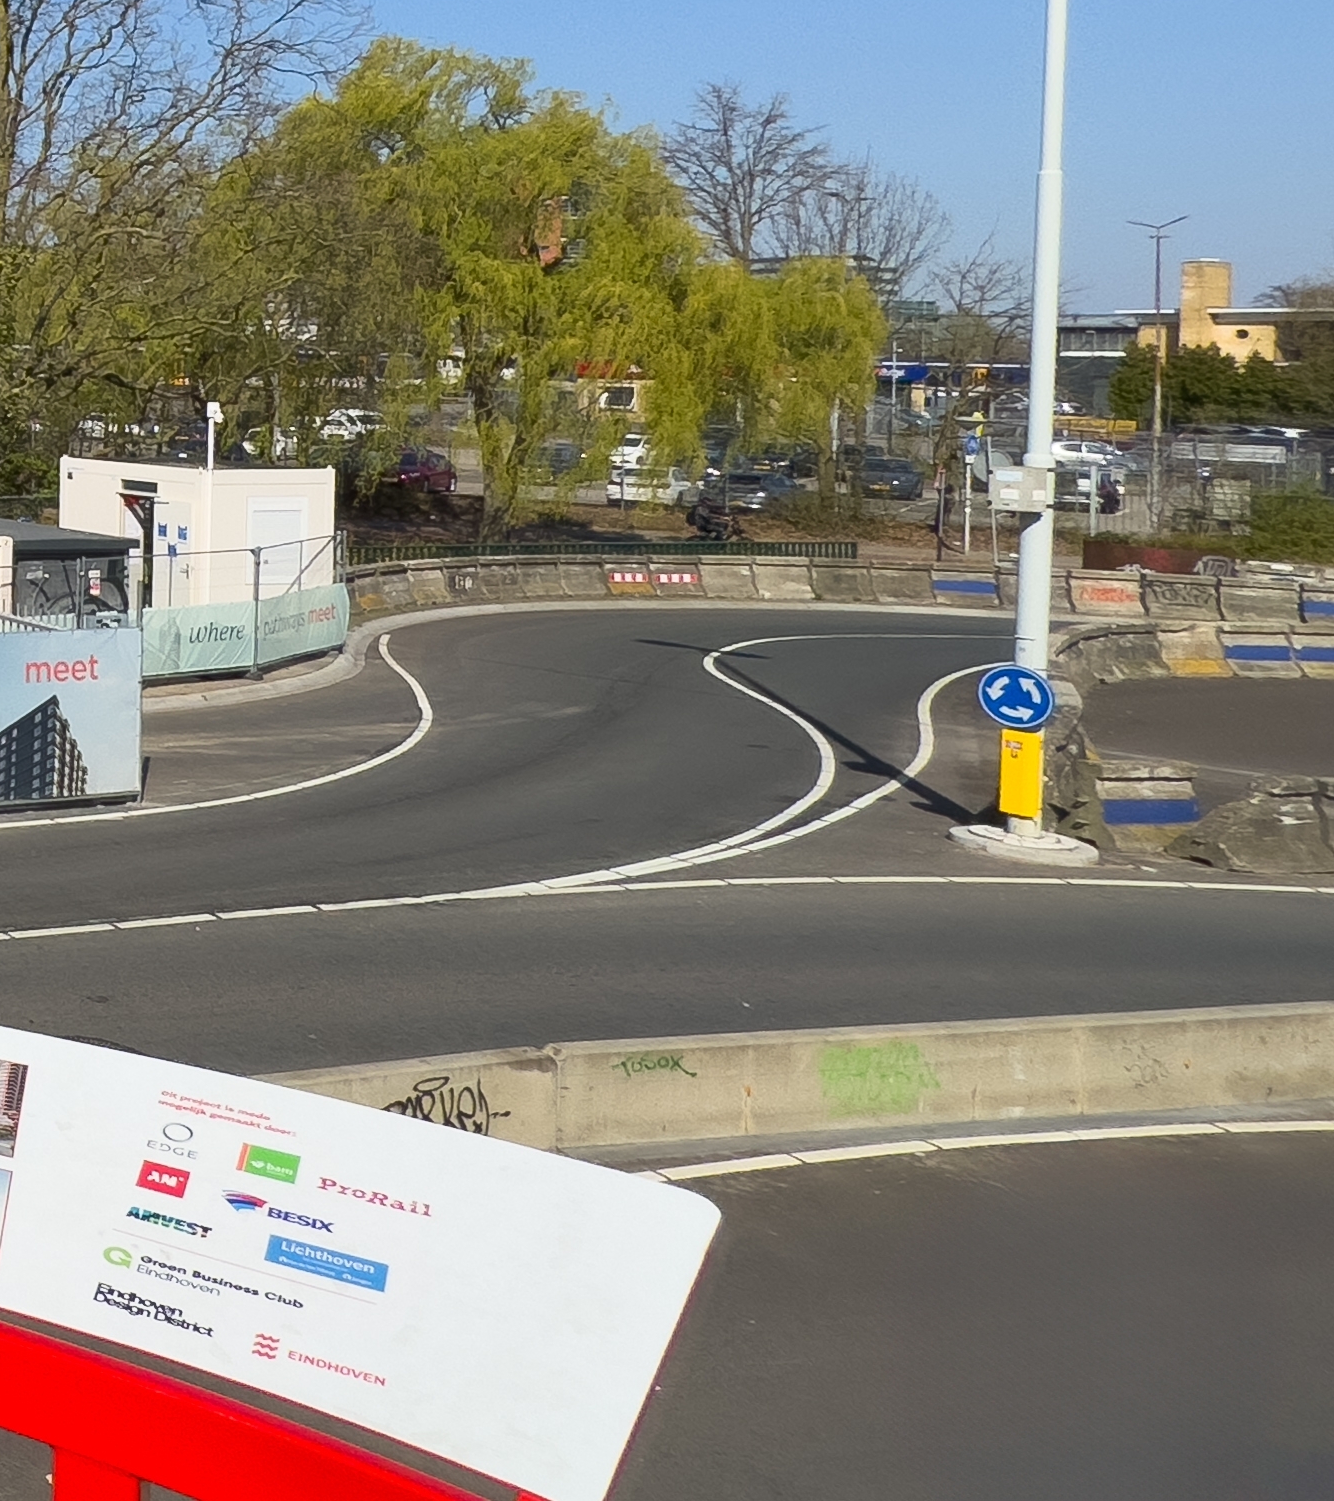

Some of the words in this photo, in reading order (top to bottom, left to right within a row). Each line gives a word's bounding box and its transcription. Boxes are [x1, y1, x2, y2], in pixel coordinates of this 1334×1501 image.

[189, 621, 245, 644] where
[308, 602, 337, 625] meet
[25, 654, 99, 684] meet
[158, 1099, 207, 1116] mogelijk
[209, 1111, 262, 1129] gemaakt
[161, 1089, 178, 1099] Dit
[180, 1095, 222, 1110] project
[224, 1104, 235, 1112] is
[237, 1109, 271, 1121] mede
[146, 1139, 198, 1160] EDGE
[266, 1162, 294, 1176] bam
[317, 1176, 432, 1217] ProRail
[267, 1206, 334, 1234] BESIX
[281, 1240, 375, 1274] Lichthoven
[136, 1264, 221, 1296] Eindhoven
[140, 1255, 188, 1276] Green
[192, 1269, 260, 1297] Business
[264, 1291, 304, 1309] Club
[93, 1290, 151, 1318] Design
[154, 1309, 214, 1337] District
[98, 1282, 183, 1318] Eindhoven
[287, 1349, 386, 1387] EINDHOVEN
